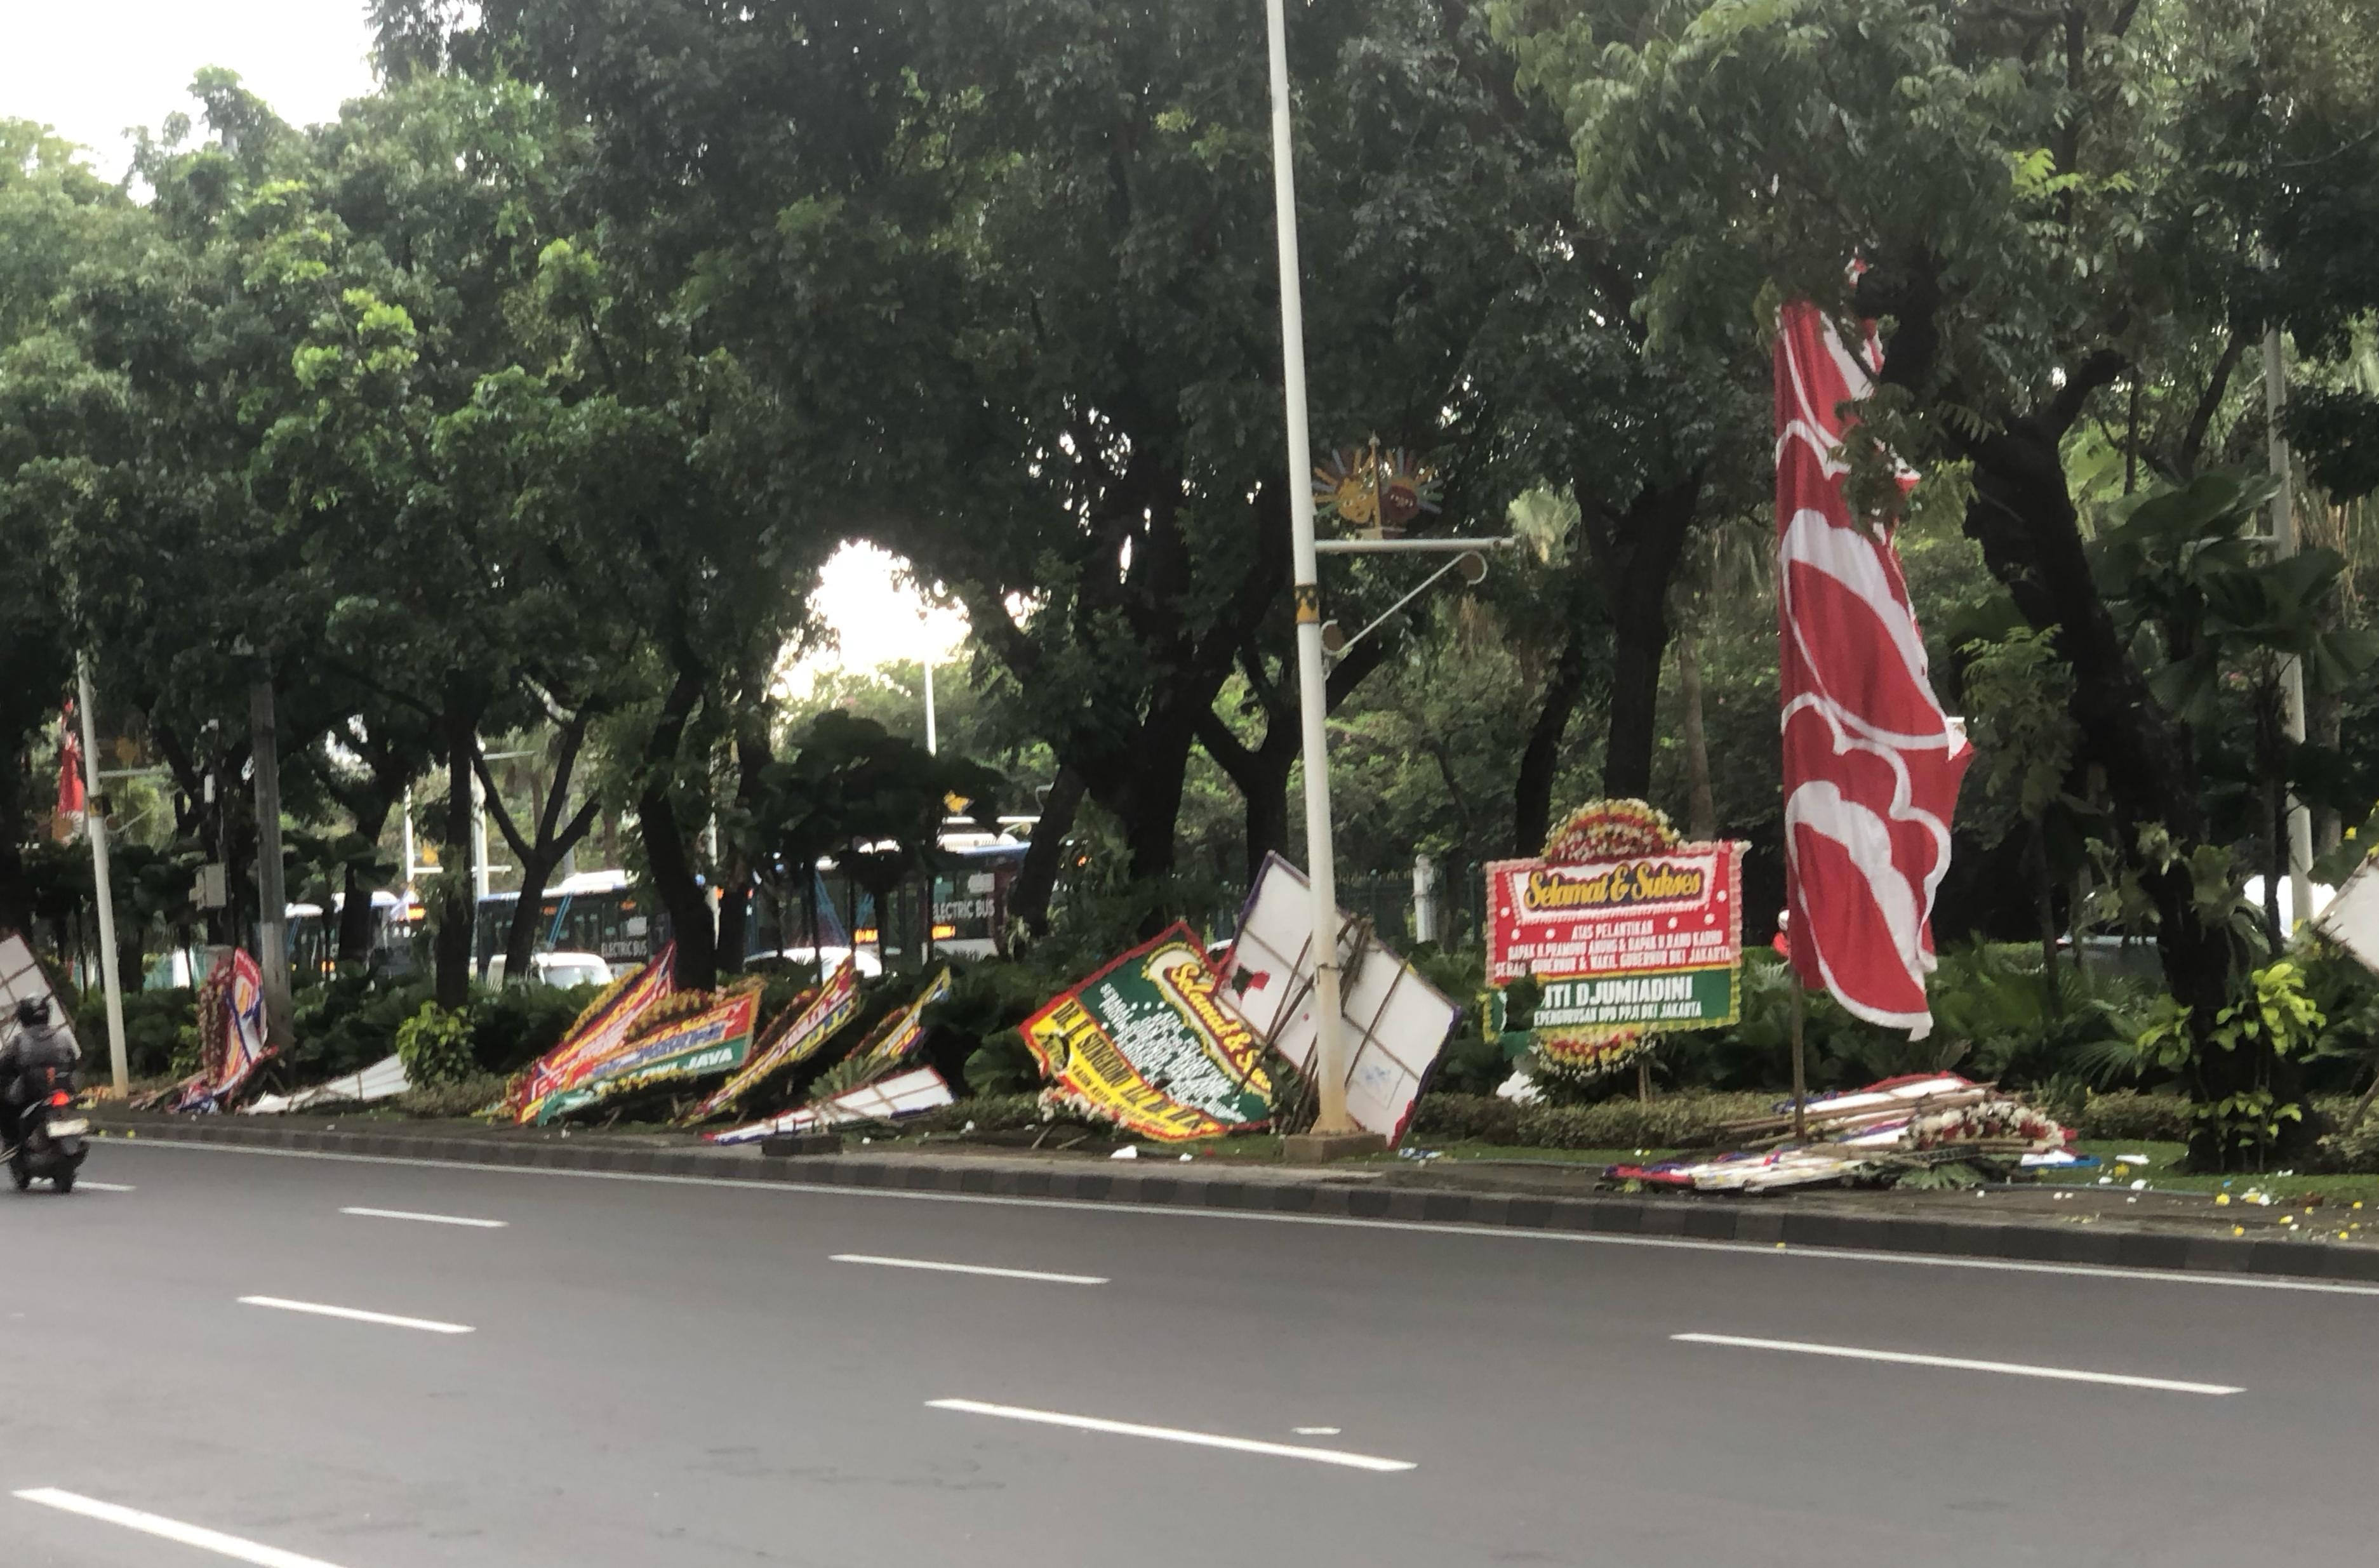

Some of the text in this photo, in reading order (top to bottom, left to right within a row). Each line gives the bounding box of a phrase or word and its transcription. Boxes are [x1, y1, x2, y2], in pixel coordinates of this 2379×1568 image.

[1524, 870, 1609, 908] Selamat
[1631, 861, 1702, 900] Sukses
[932, 898, 996, 920] ELECTRIC BUS
[1571, 924, 1594, 941] ATAS
[1171, 962, 1242, 1037] Selamat
[1576, 976, 1693, 1007] DJUMIADINI
